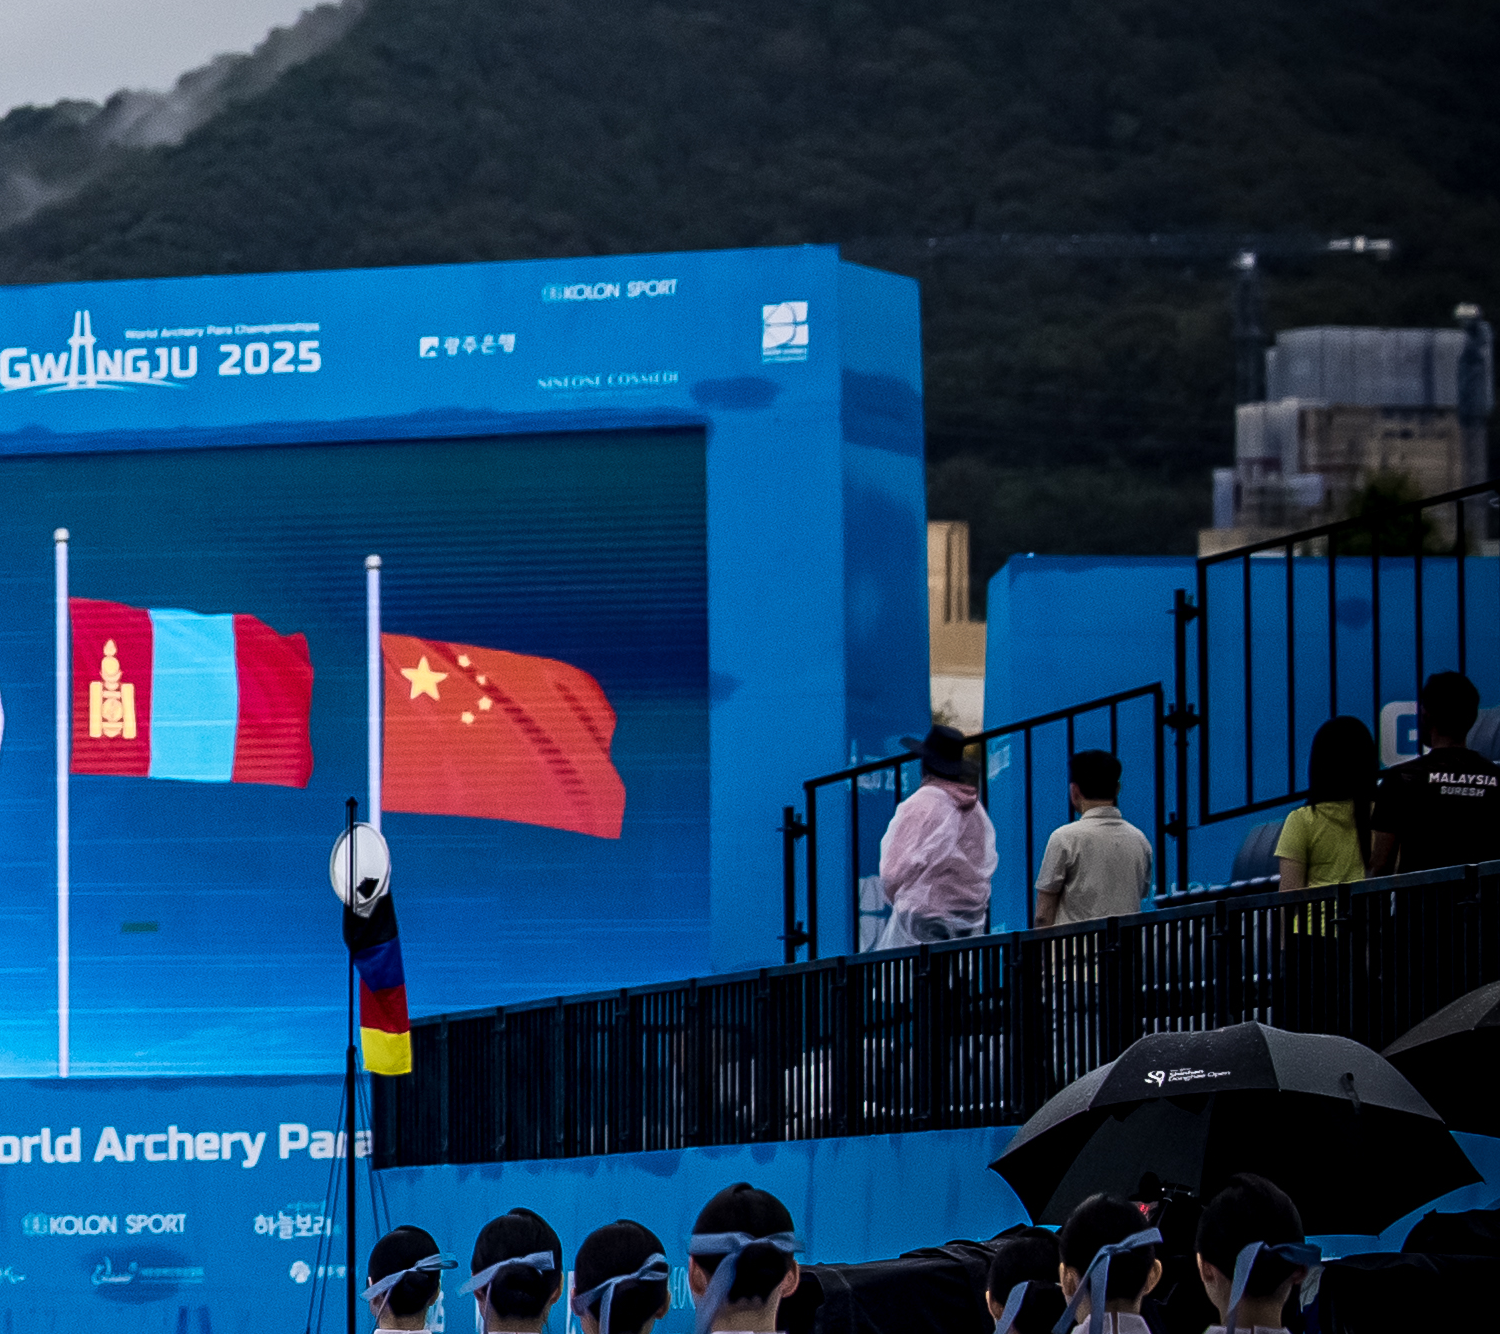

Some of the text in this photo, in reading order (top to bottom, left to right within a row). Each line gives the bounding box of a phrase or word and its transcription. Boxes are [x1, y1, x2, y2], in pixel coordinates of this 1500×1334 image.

[218, 340, 322, 376] 2025
[1428, 772, 1498, 787] MALAYSIA
[93, 1125, 266, 1169] Archery
[49, 1213, 187, 1236] KOLON SPORT
